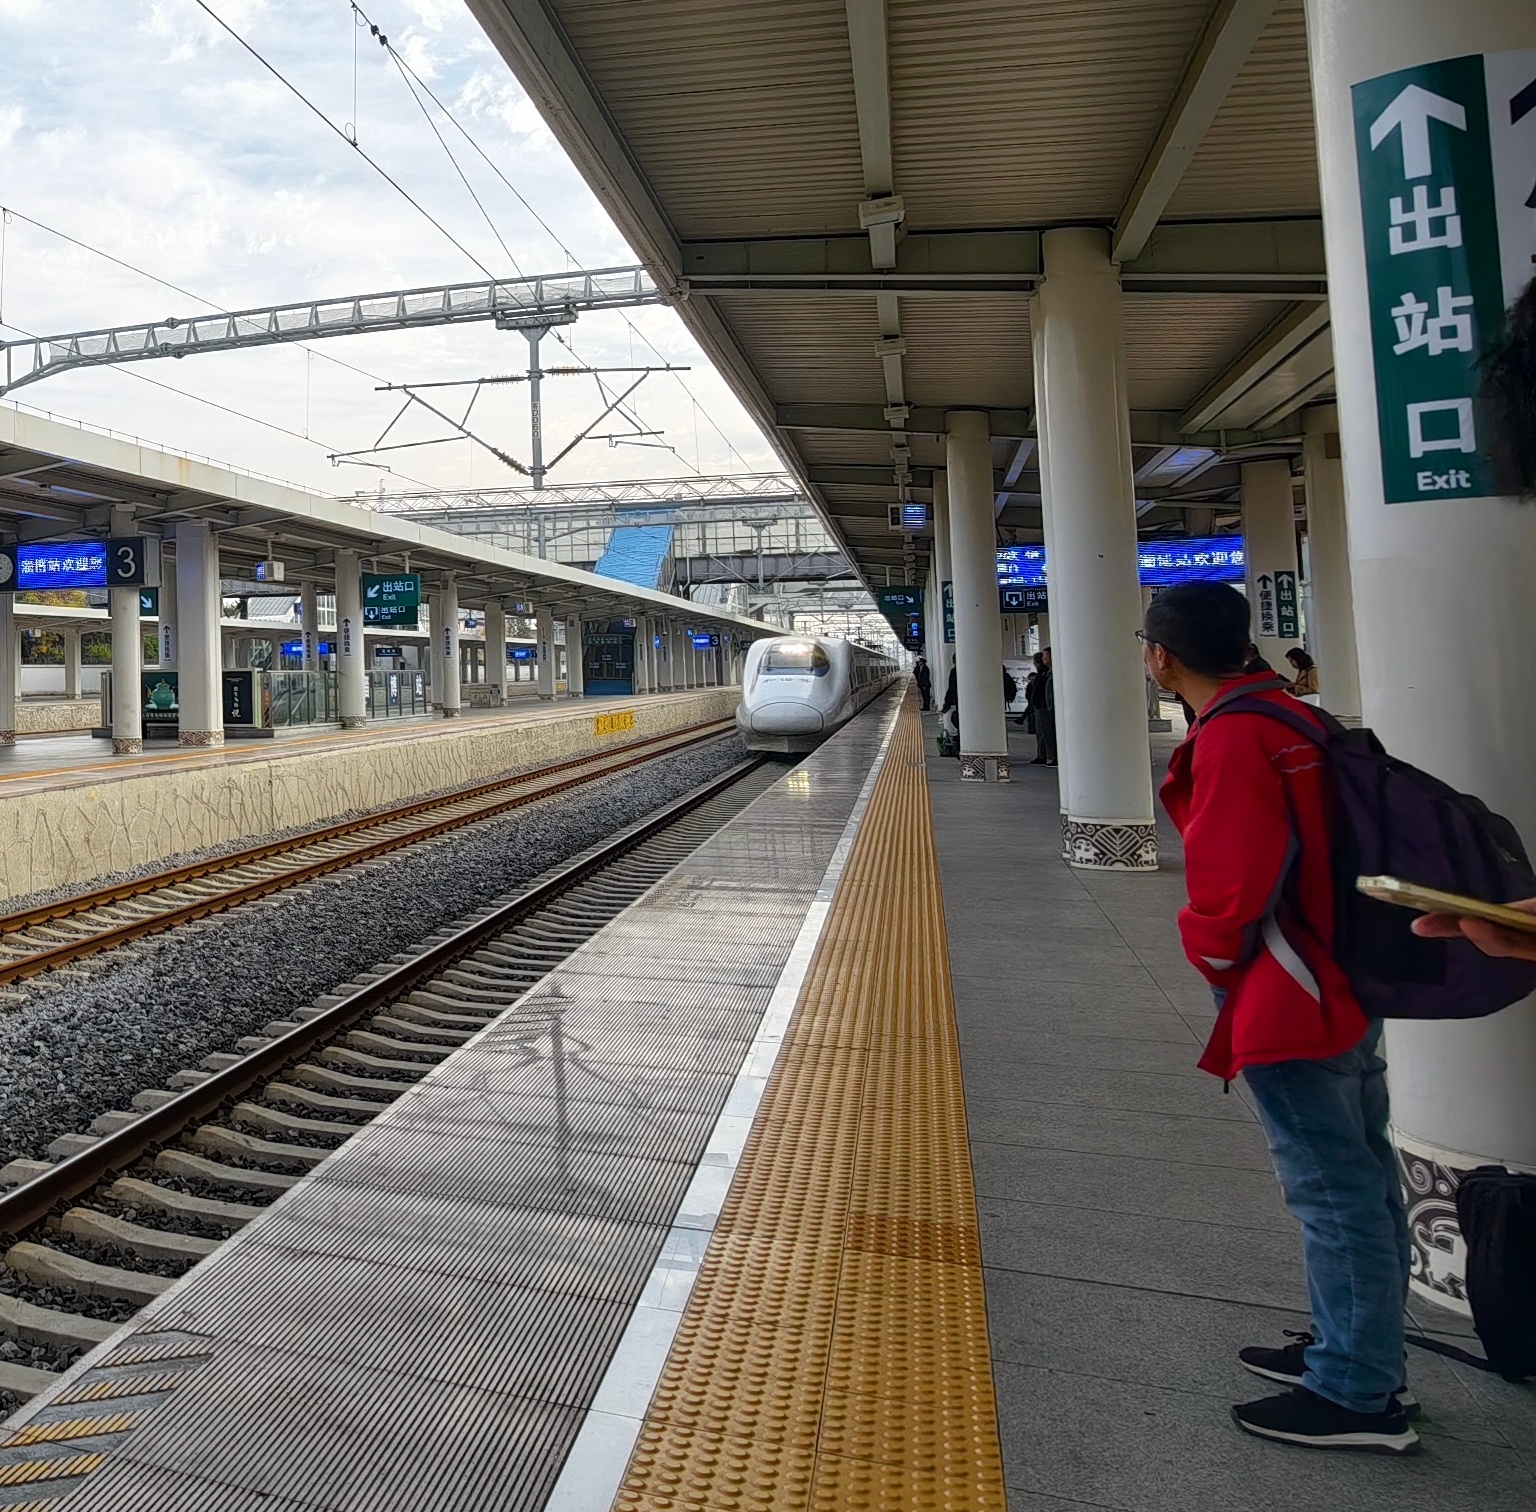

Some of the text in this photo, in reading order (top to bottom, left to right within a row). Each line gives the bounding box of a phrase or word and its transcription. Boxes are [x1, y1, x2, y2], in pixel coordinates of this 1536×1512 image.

[1389, 185, 1477, 459] 出站口
[1417, 469, 1472, 491] Exit
[117, 546, 136, 578] 3
[383, 581, 414, 593] 出站口
[381, 606, 406, 614] 出站口
[1259, 590, 1275, 632] 便捷换乘
[1280, 589, 1294, 632] 出站口
[711, 634, 719, 645] 3
